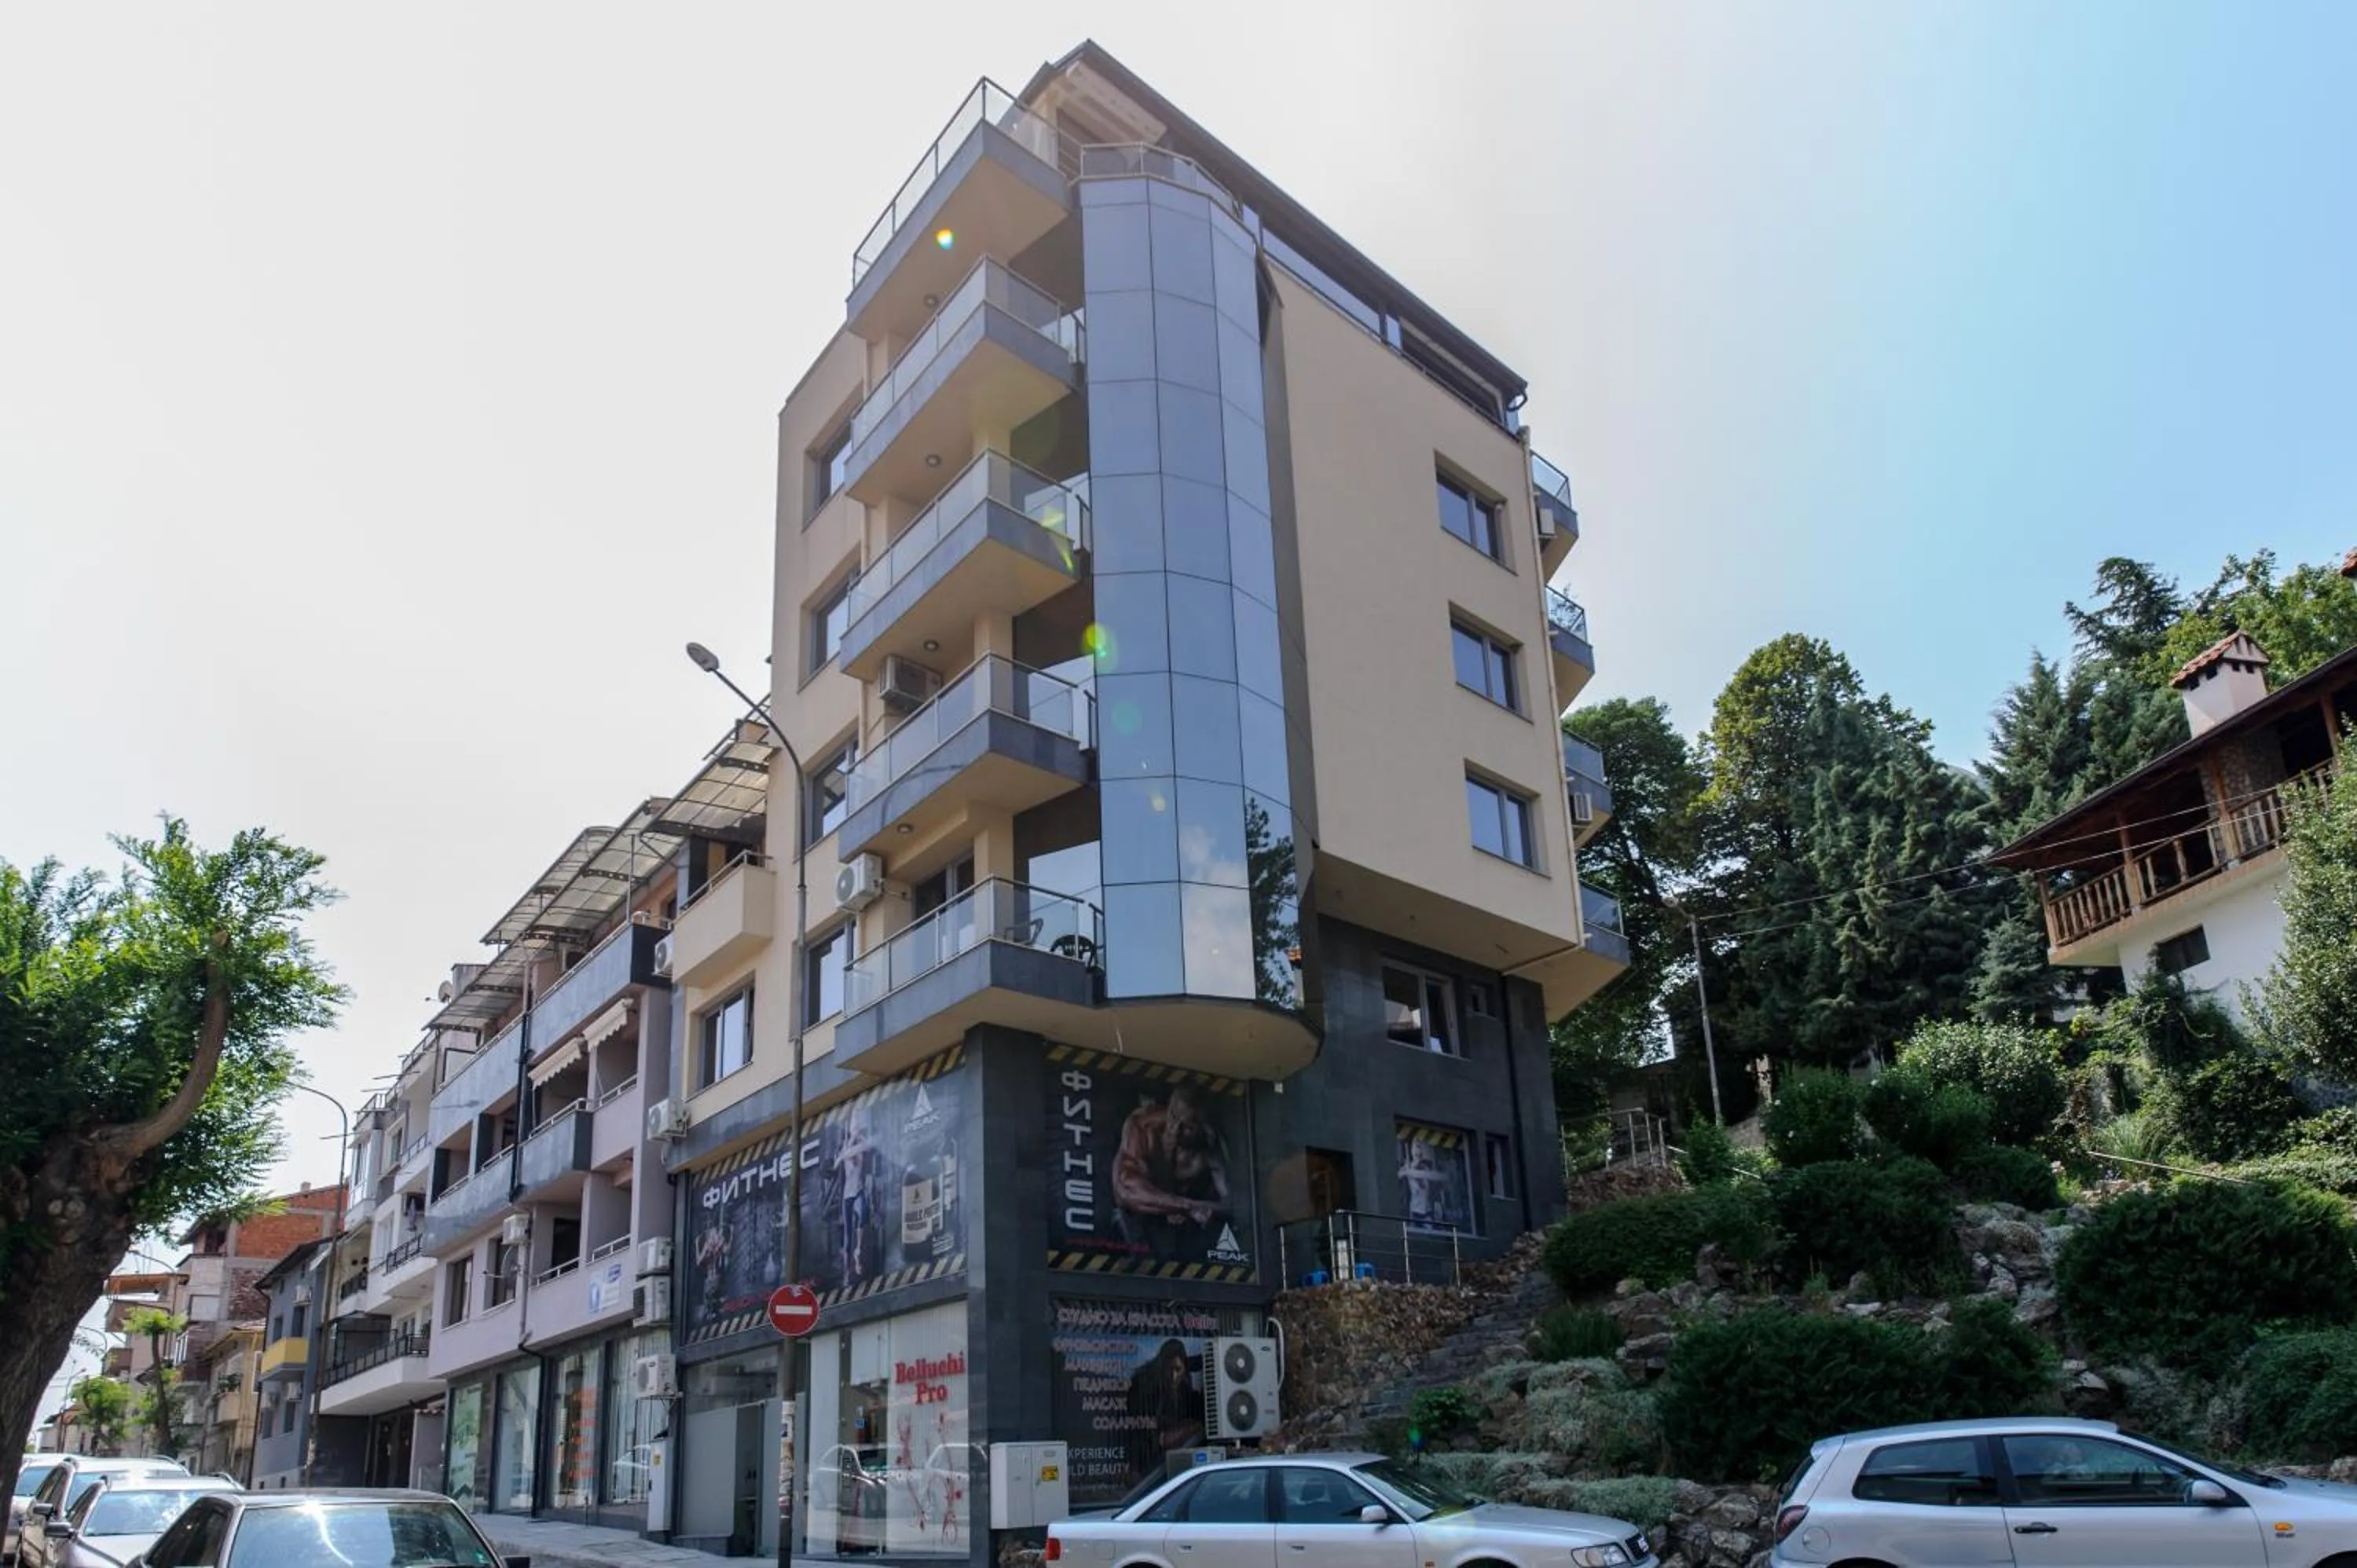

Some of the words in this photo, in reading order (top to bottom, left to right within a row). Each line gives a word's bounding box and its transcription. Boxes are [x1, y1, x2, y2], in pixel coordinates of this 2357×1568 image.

[904, 1111, 940, 1133] PEAK
[1061, 1070, 1094, 1231] ФИТНЕС
[702, 1139, 819, 1209] ФИТНЕС
[1208, 1250, 1250, 1262] PEAK
[916, 1382, 948, 1405] Pro
[1067, 1446, 1125, 1460] XPERIENCE
[1088, 1462, 1130, 1476] BEAUTY
